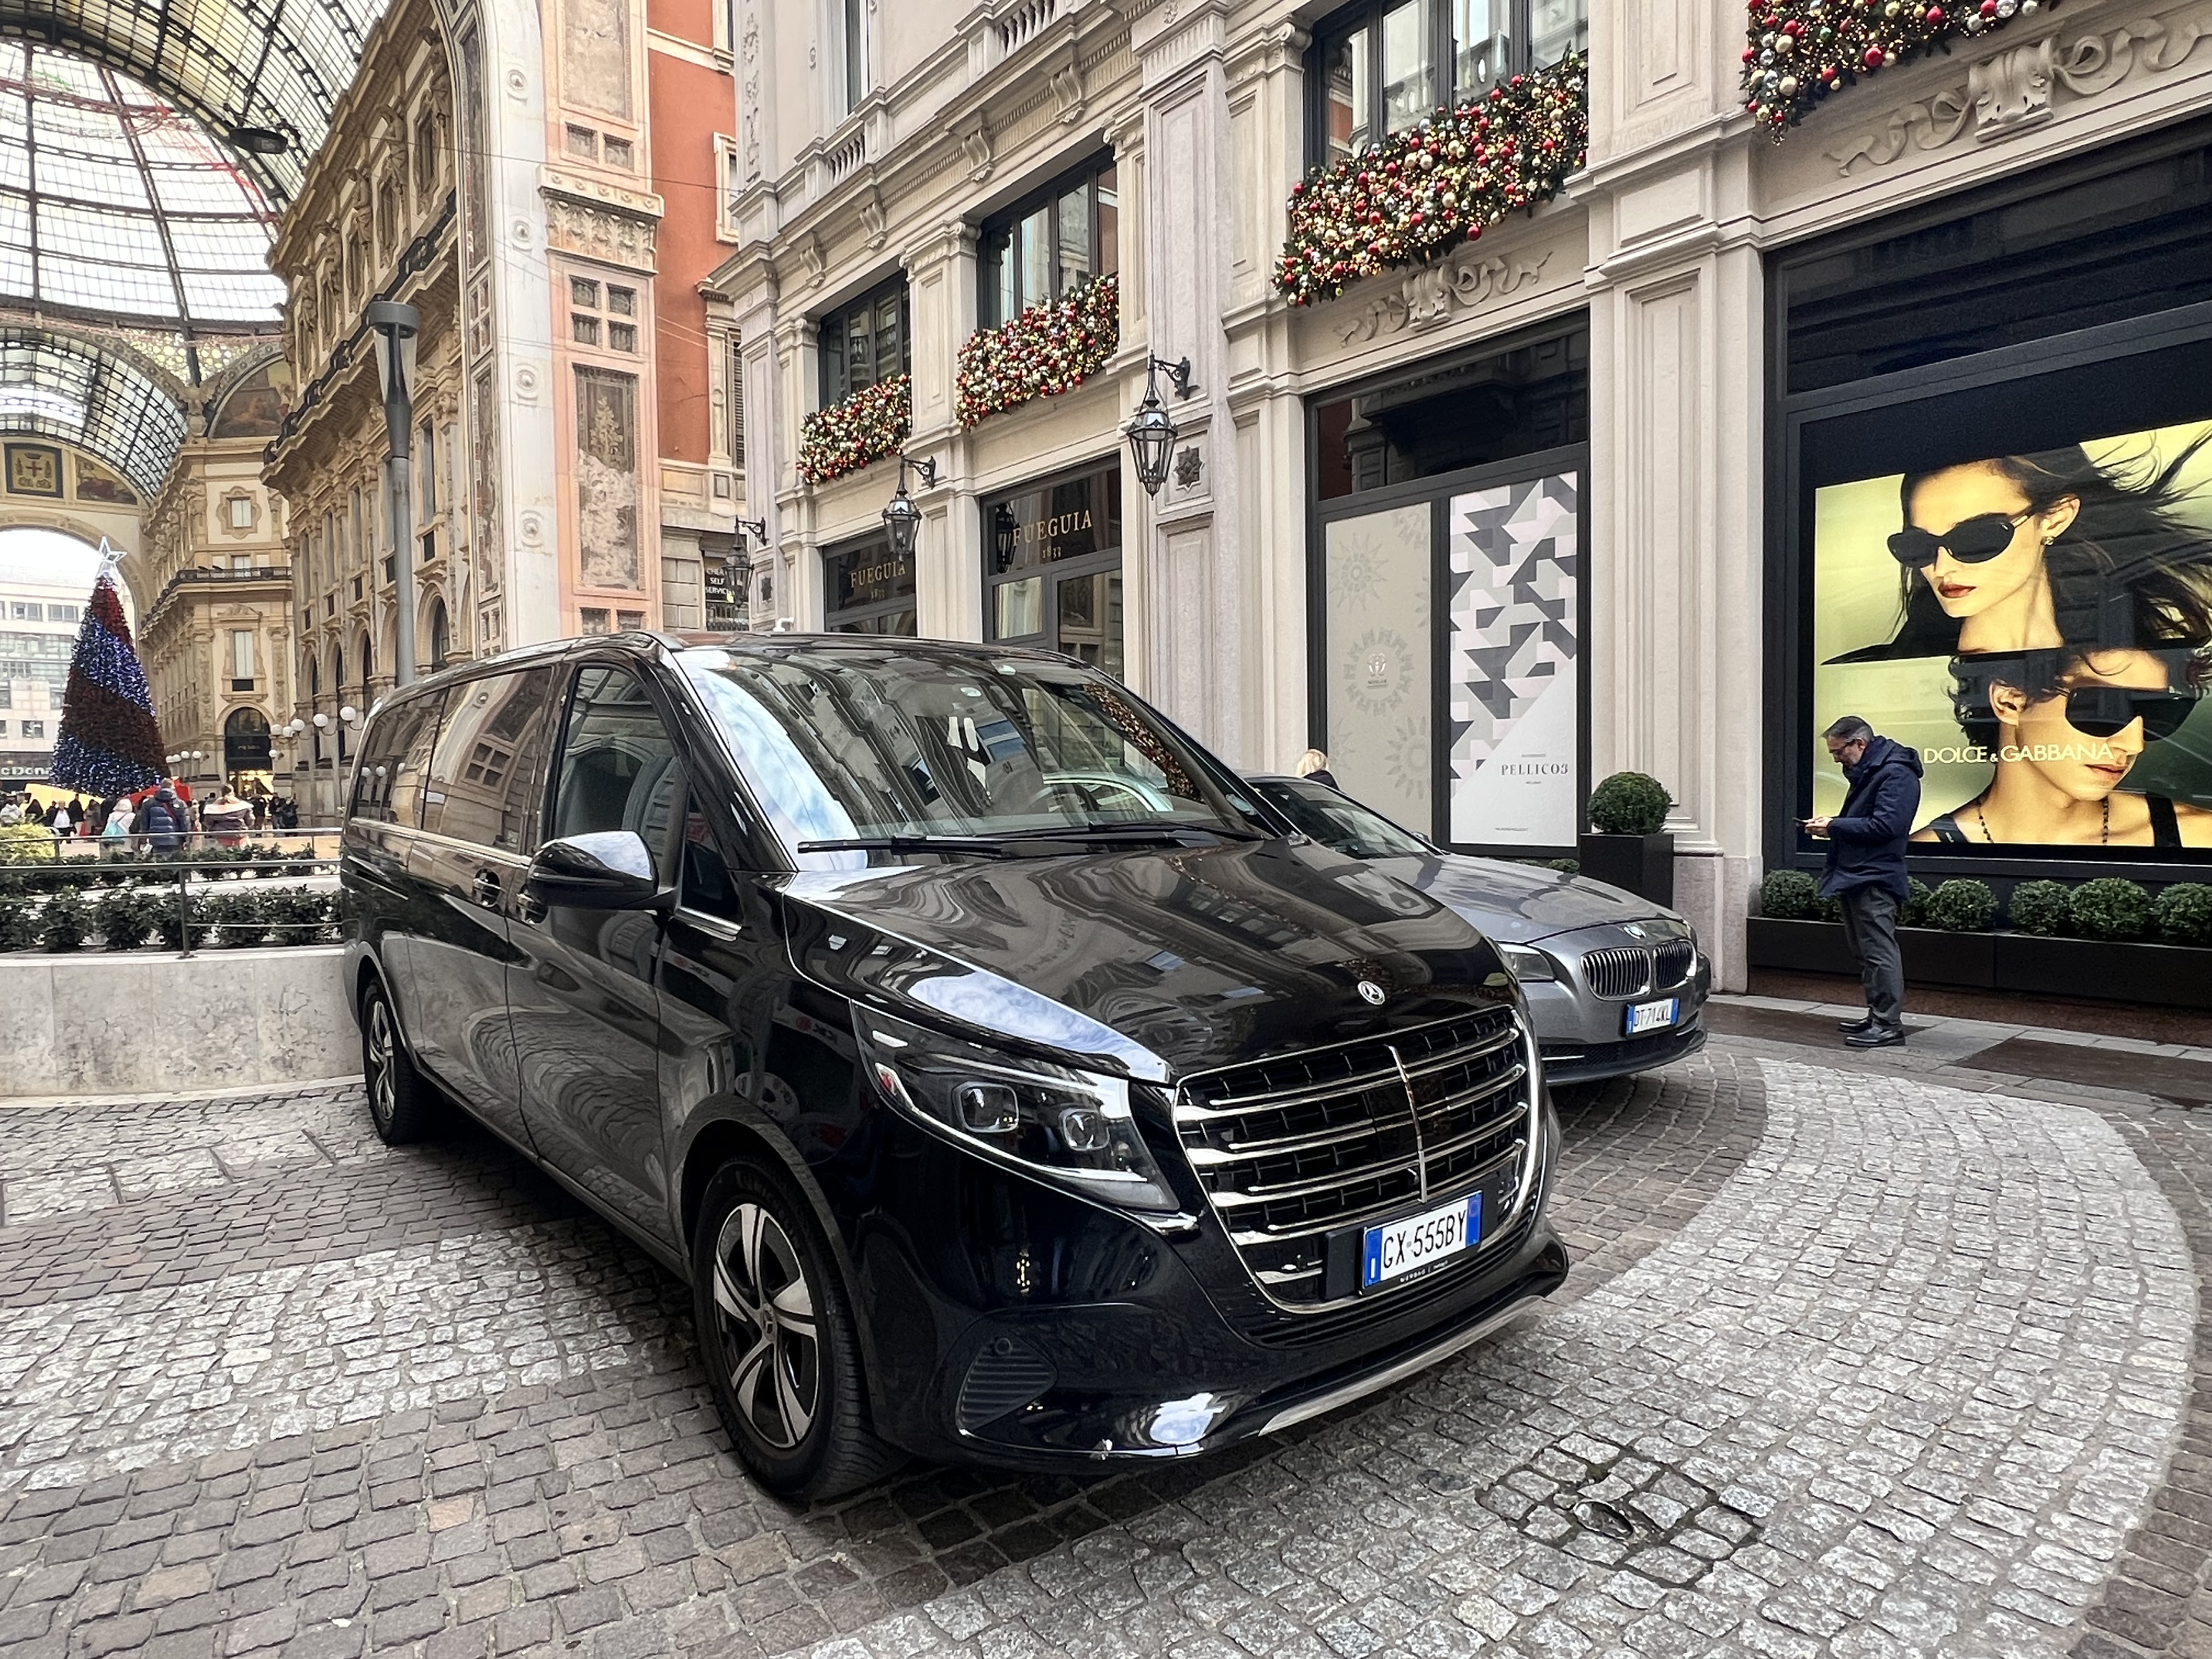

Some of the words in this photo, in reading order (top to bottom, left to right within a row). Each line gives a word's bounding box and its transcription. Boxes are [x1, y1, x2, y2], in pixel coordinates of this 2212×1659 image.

[1013, 510, 1092, 546] FUEGUIA
[709, 577, 725, 585] SELF
[850, 561, 905, 588] FUEGUIA
[1923, 746, 1988, 764] DOLCE
[1989, 752, 1999, 763] &
[2000, 743, 2114, 763] GABBANA
[1383, 1230, 1407, 1269] GX
[1413, 1209, 1466, 1257] 555BY
